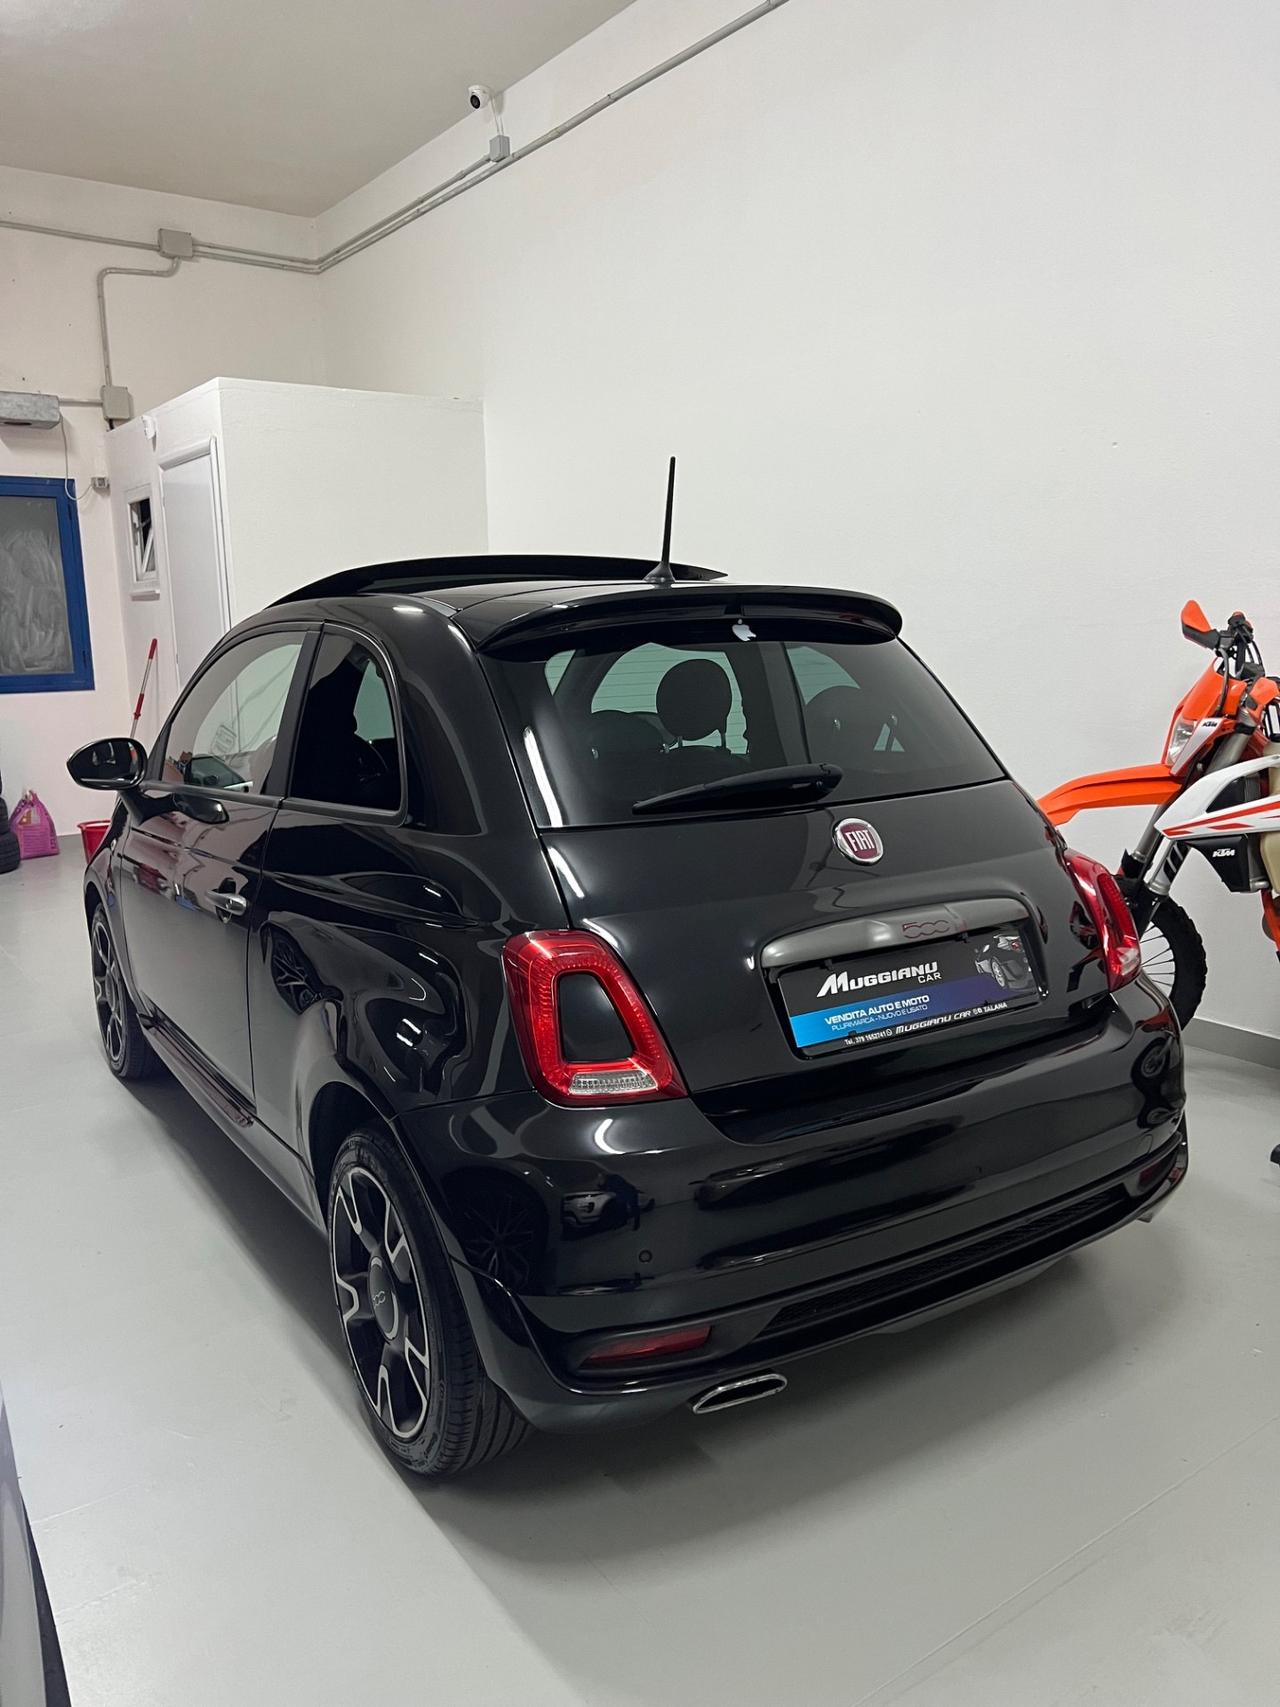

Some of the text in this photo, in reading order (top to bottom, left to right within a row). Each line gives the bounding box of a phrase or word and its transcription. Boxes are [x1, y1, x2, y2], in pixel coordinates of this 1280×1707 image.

[845, 829, 875, 852] FIAT
[1212, 848, 1235, 858] KTM
[902, 920, 950, 939] 500
[918, 972, 942, 984] CAR
[824, 995, 930, 1025] VENDITA AUTO E MOTO
[895, 1014, 952, 1033] MUGGIANU
[953, 1010, 971, 1020] CAR
